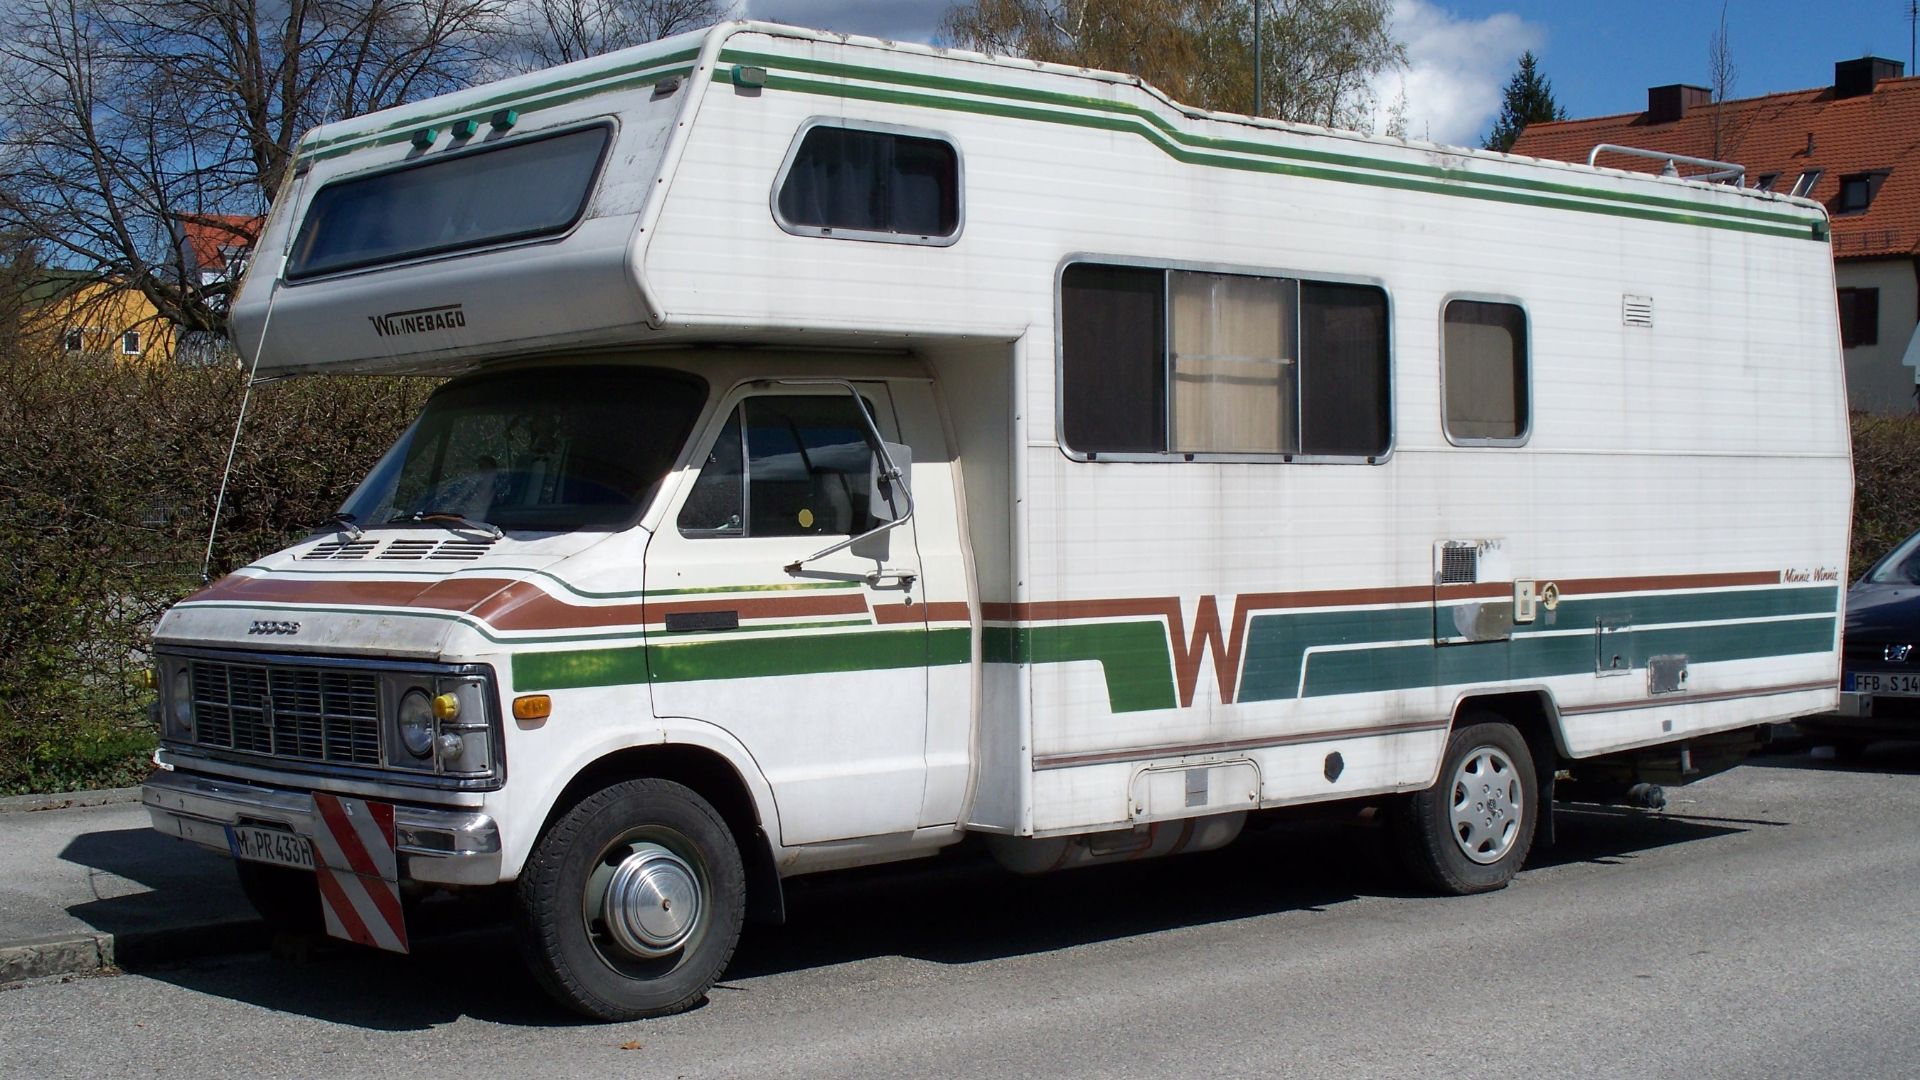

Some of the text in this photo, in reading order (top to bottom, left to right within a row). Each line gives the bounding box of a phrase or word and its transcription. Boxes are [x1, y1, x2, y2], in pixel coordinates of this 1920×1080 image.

[1165, 594, 1248, 708] W
[1856, 675, 1920, 692] FFB S 14
[234, 829, 312, 865] M PR 433H
